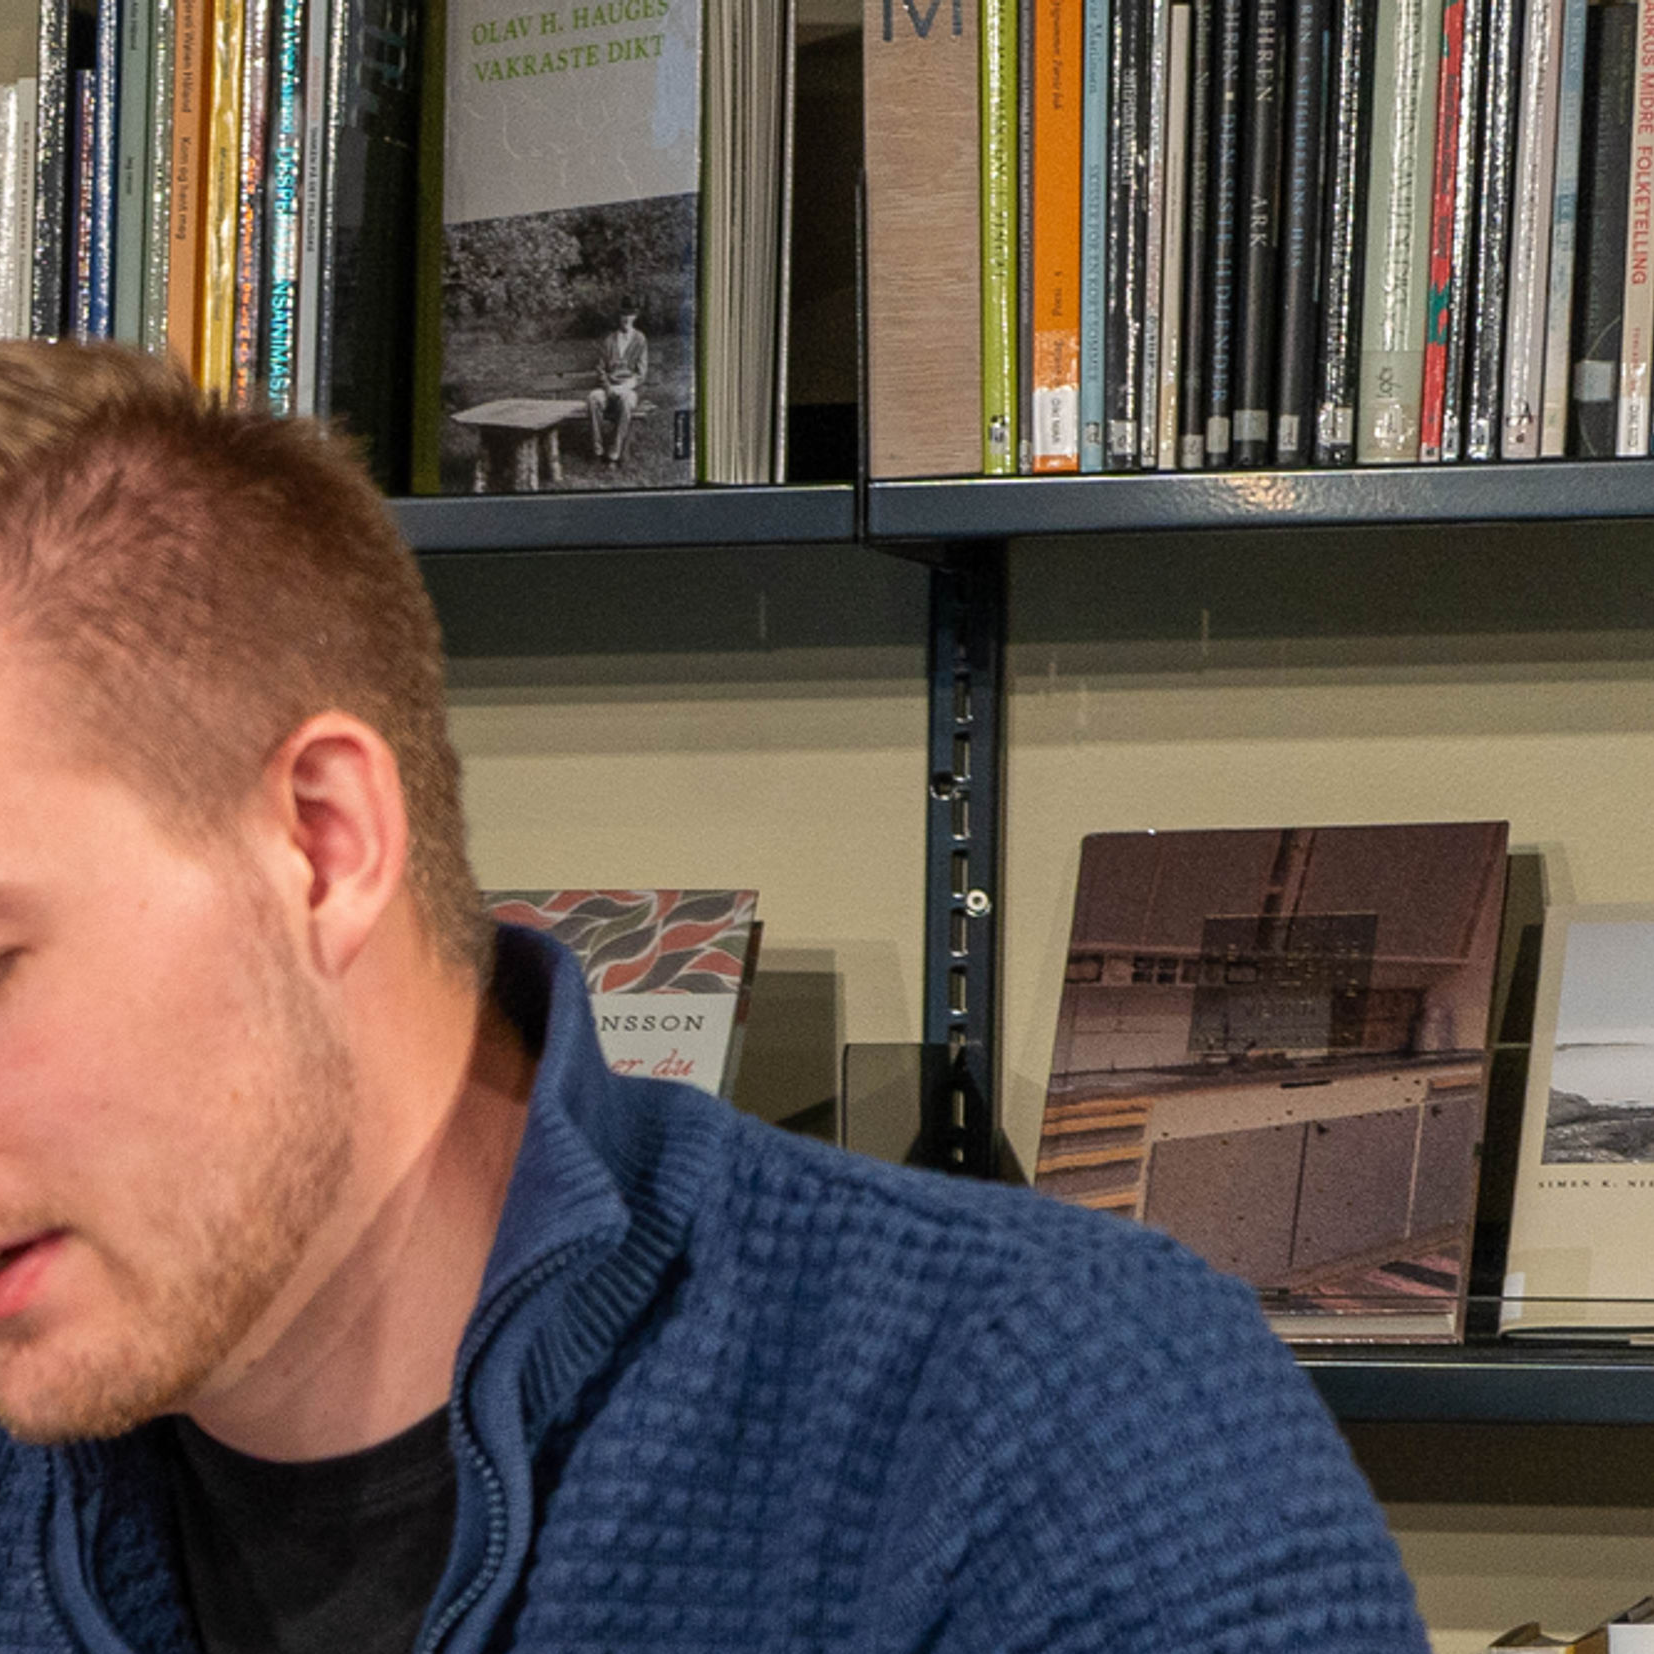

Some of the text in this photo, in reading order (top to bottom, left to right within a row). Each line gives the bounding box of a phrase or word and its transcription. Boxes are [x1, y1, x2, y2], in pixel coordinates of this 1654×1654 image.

[472, 0, 670, 46] OLAV H. HAUGES
[473, 33, 666, 83] VAKRASTE DIKT
[1250, 196, 1269, 248] ARK
[1630, 145, 1653, 285] FOLKETELLING
[598, 1014, 706, 1032] NSSON
[651, 1047, 696, 1078] du
